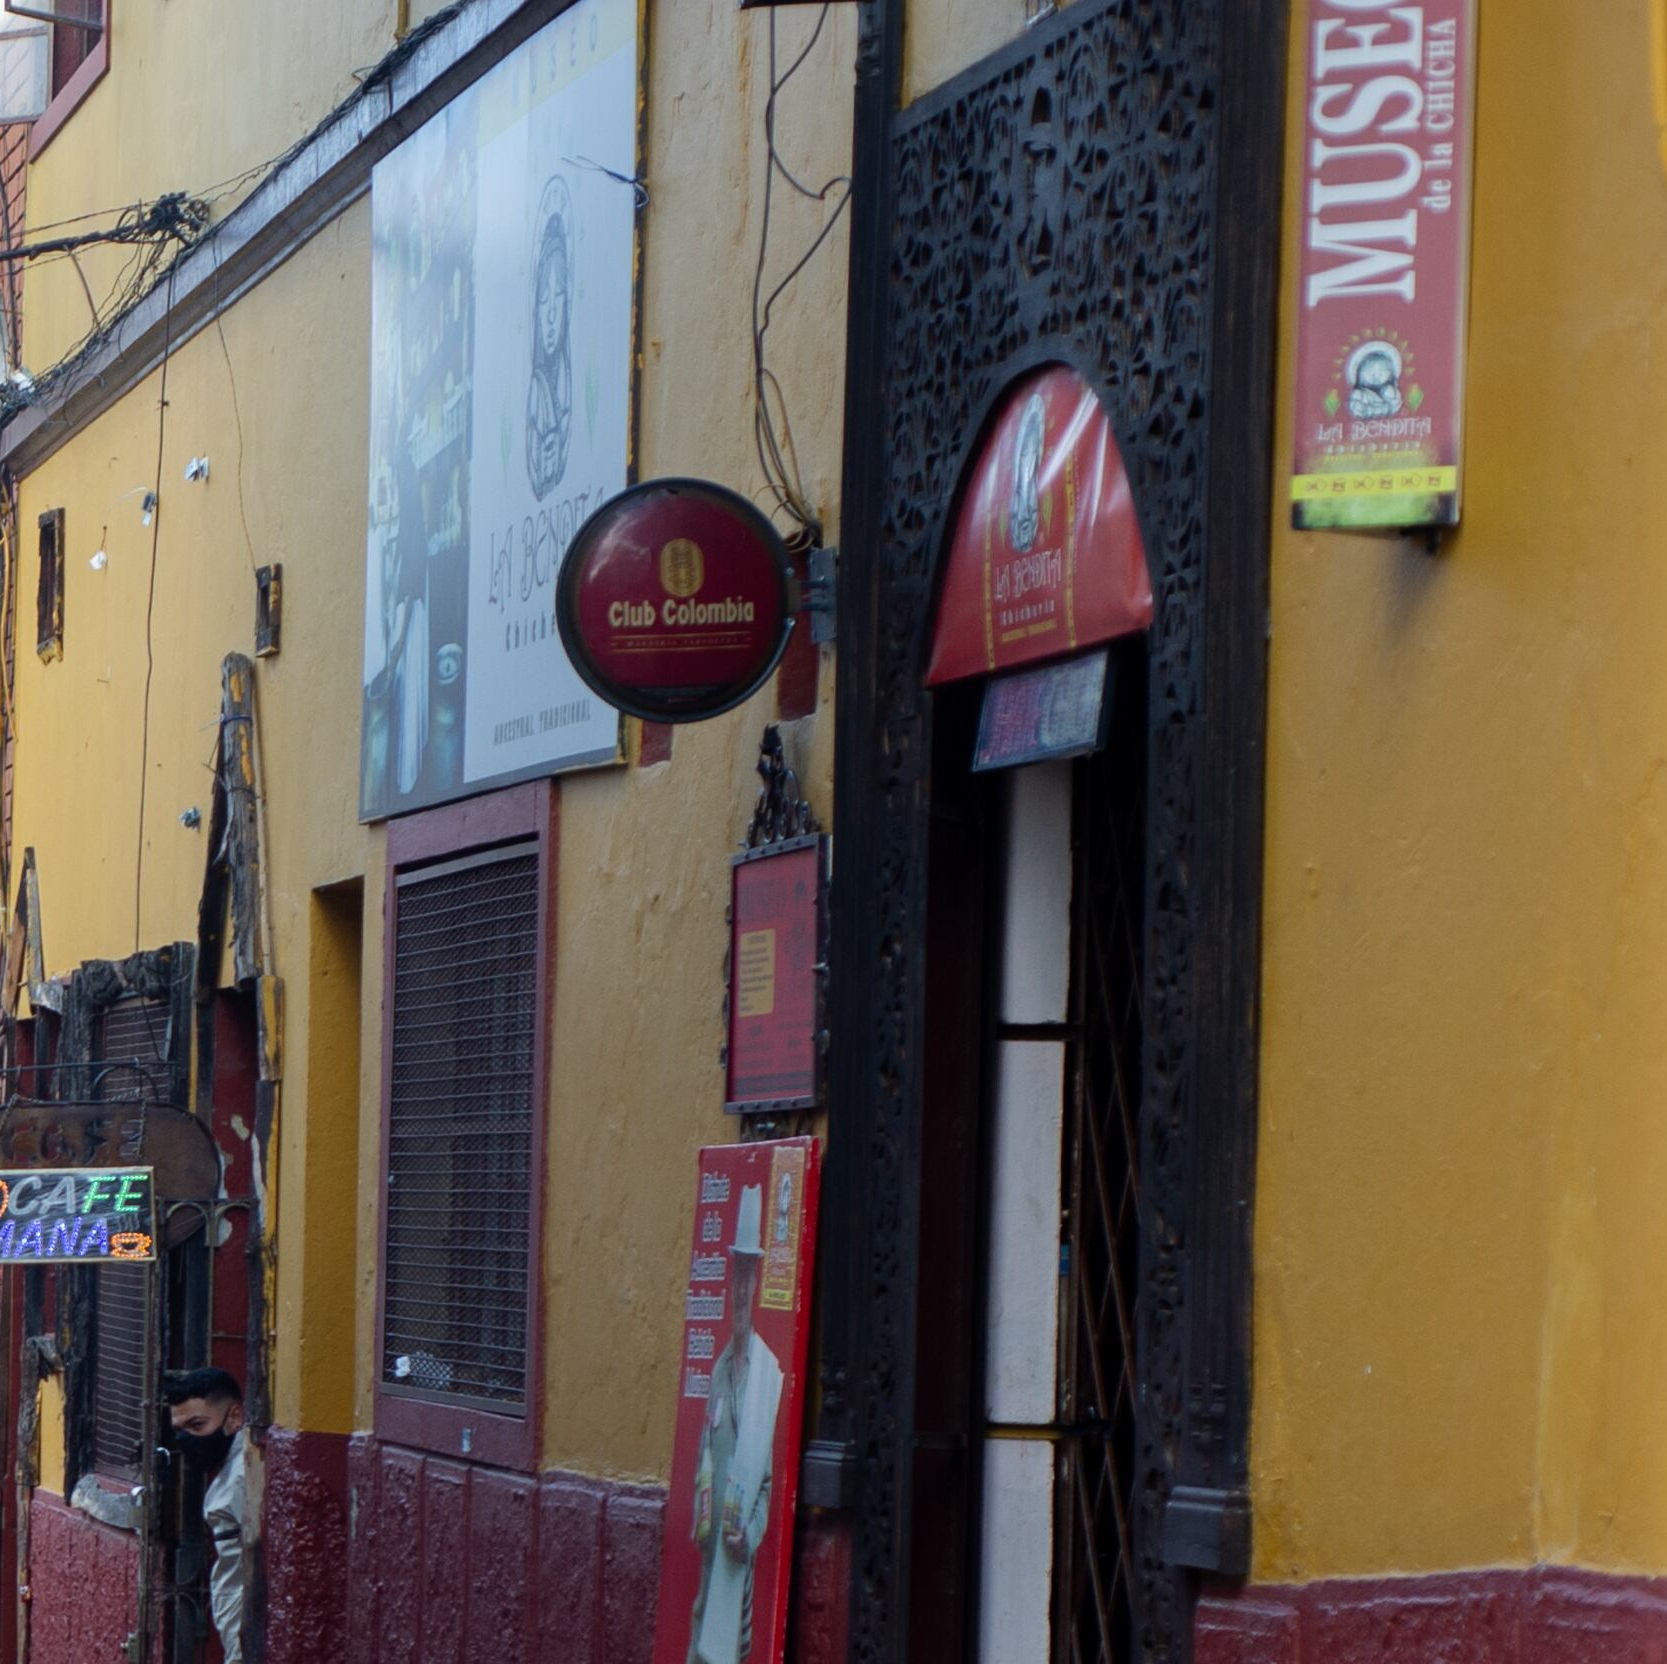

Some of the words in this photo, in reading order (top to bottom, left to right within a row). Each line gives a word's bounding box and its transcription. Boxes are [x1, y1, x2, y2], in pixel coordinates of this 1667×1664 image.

[1425, 17, 1457, 132] CHICHA
[1306, 0, 1424, 307] MUSE
[1424, 142, 1454, 170] la
[1422, 179, 1452, 213] de
[609, 600, 656, 627] Club
[662, 595, 755, 626] Colombia
[7, 1173, 149, 1216] CAFE
